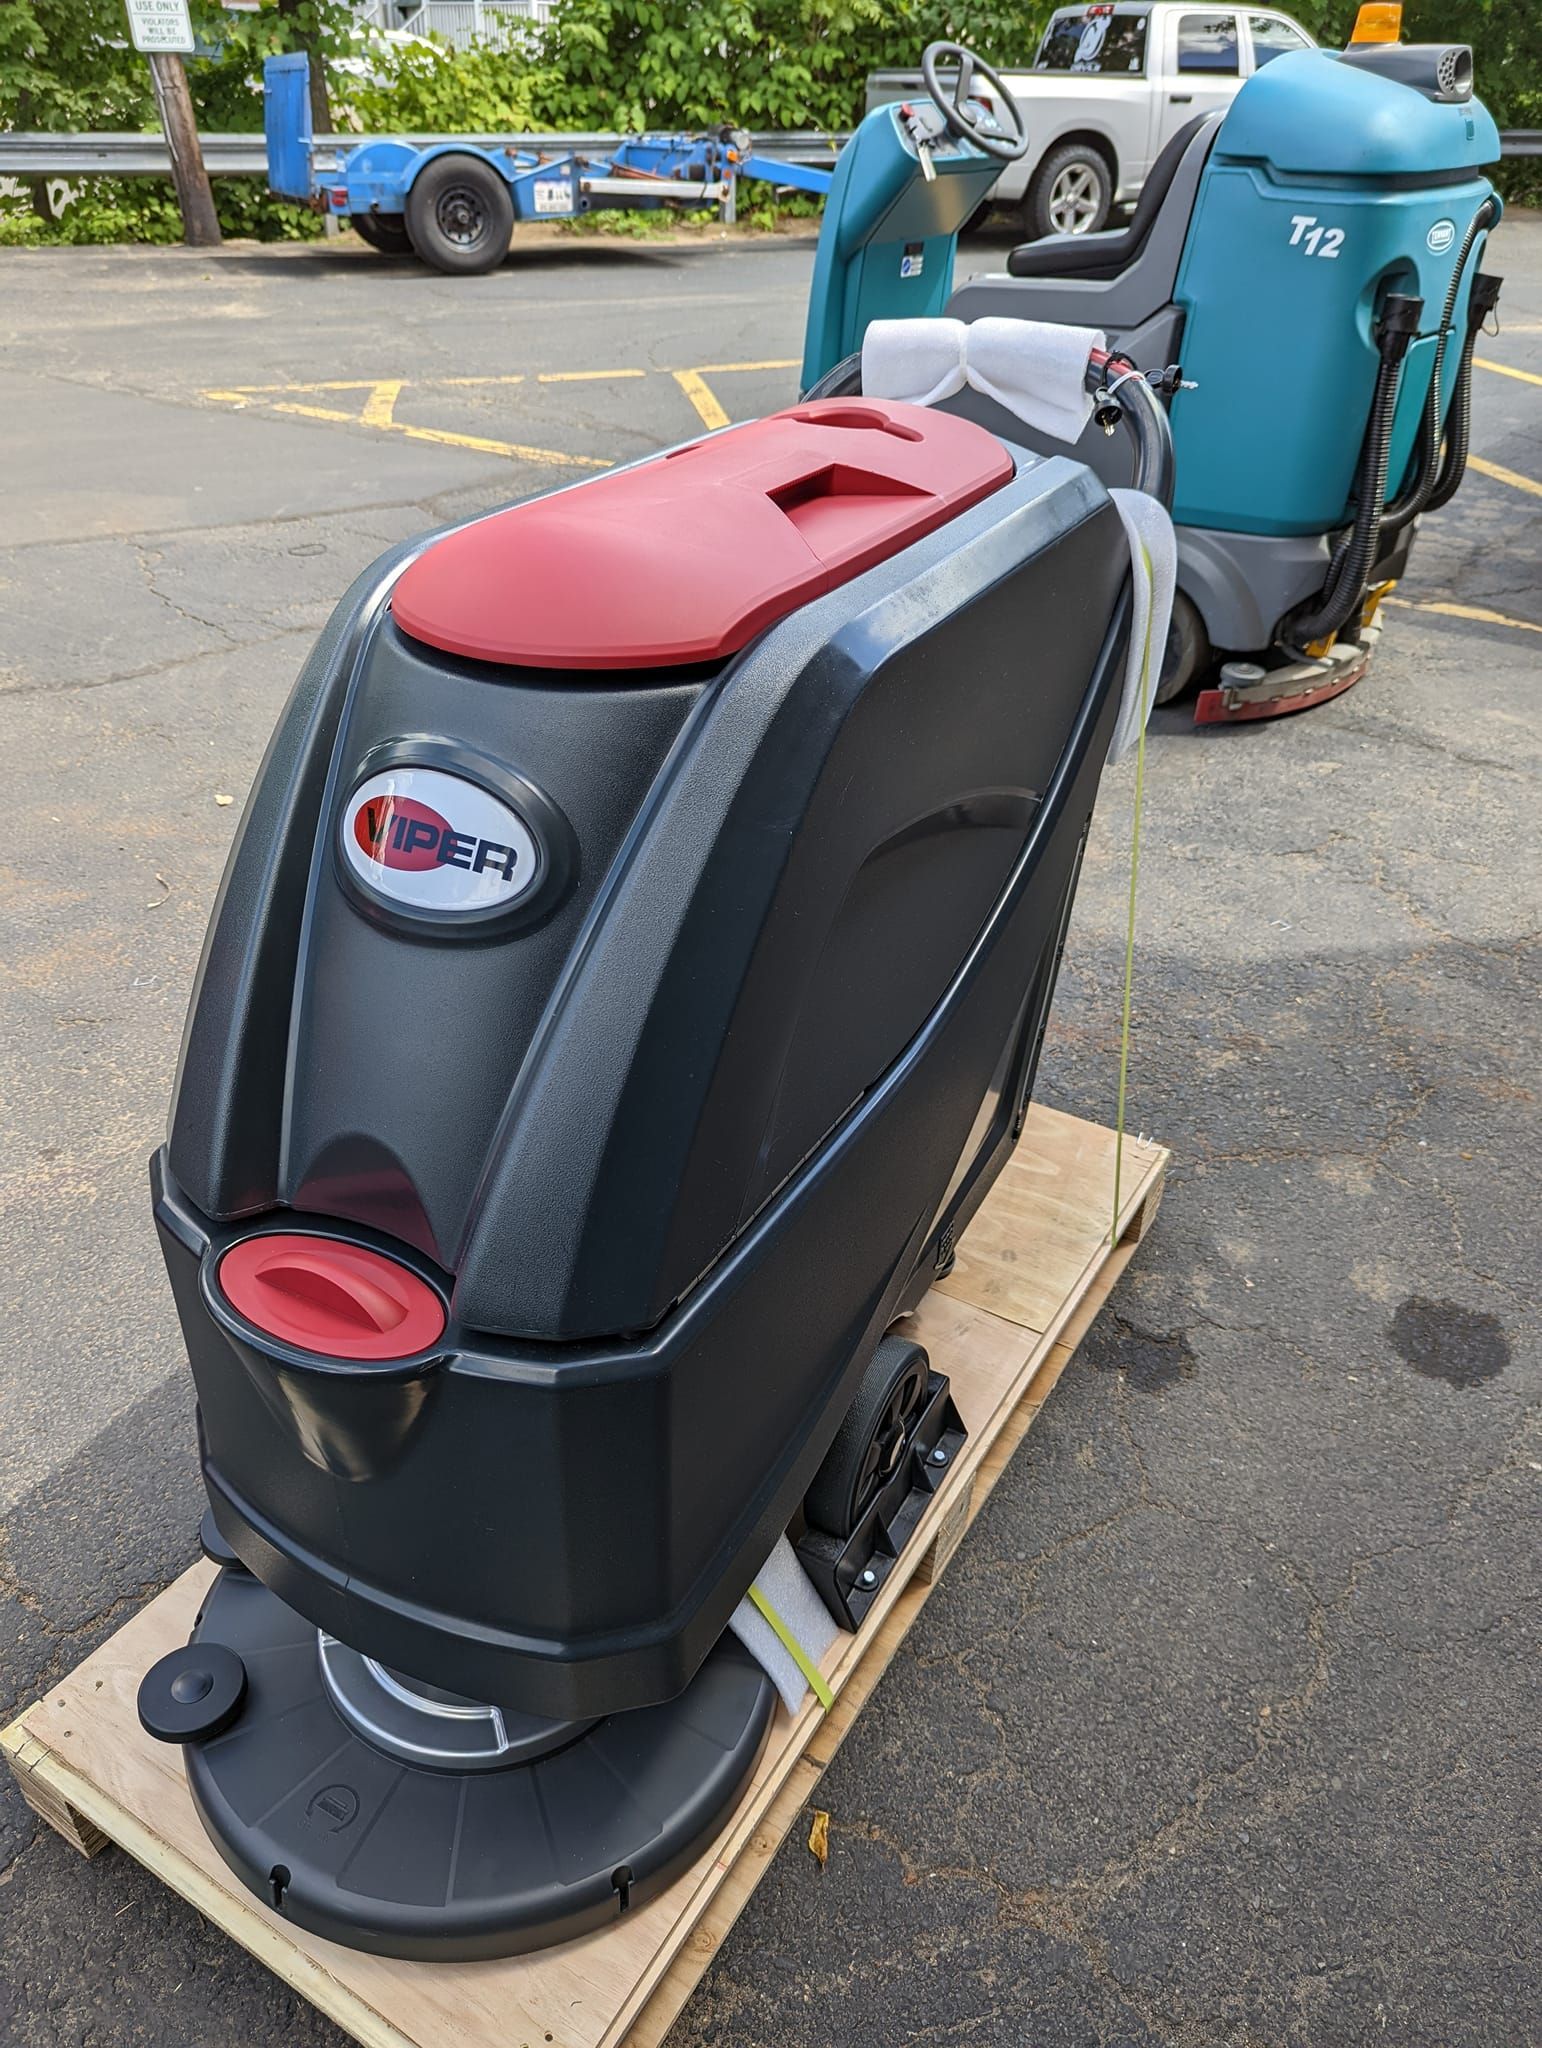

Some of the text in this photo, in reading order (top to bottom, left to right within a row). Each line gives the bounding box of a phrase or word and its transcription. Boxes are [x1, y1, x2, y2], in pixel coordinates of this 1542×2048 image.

[135, 1, 179, 12] USE ONLY
[142, 17, 180, 26] VIOLATORS
[148, 27, 177, 35] WILL BE
[1289, 215, 1345, 258] T12
[367, 807, 518, 882] VIPER
